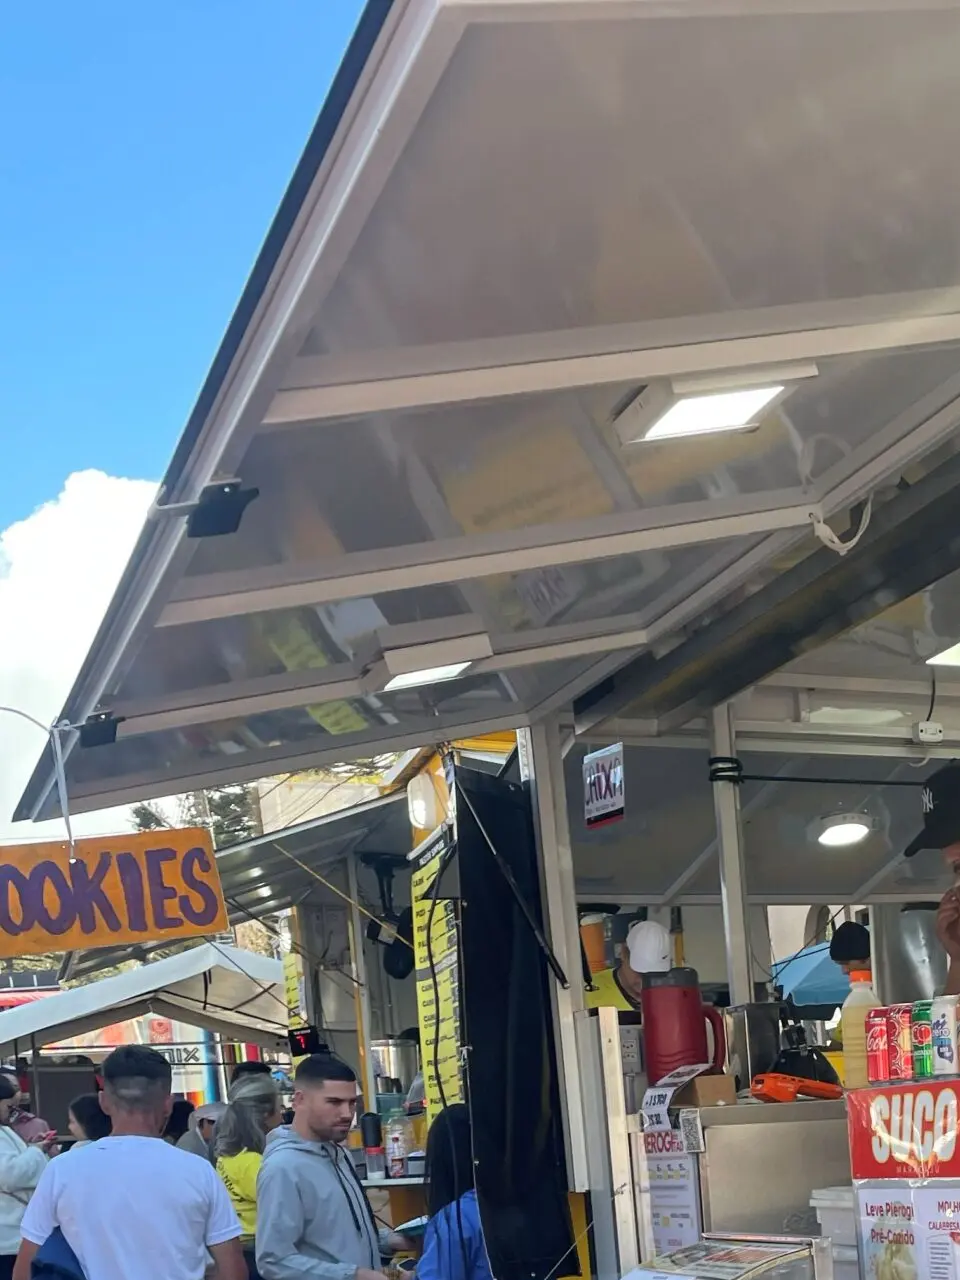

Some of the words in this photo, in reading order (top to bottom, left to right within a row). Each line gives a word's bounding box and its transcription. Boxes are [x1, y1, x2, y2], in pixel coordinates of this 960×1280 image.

[0, 847, 219, 936] OOKIES
[870, 1088, 958, 1163] SUCO
[865, 1203, 883, 1217] Leve
[886, 1202, 914, 1221] Pierogi
